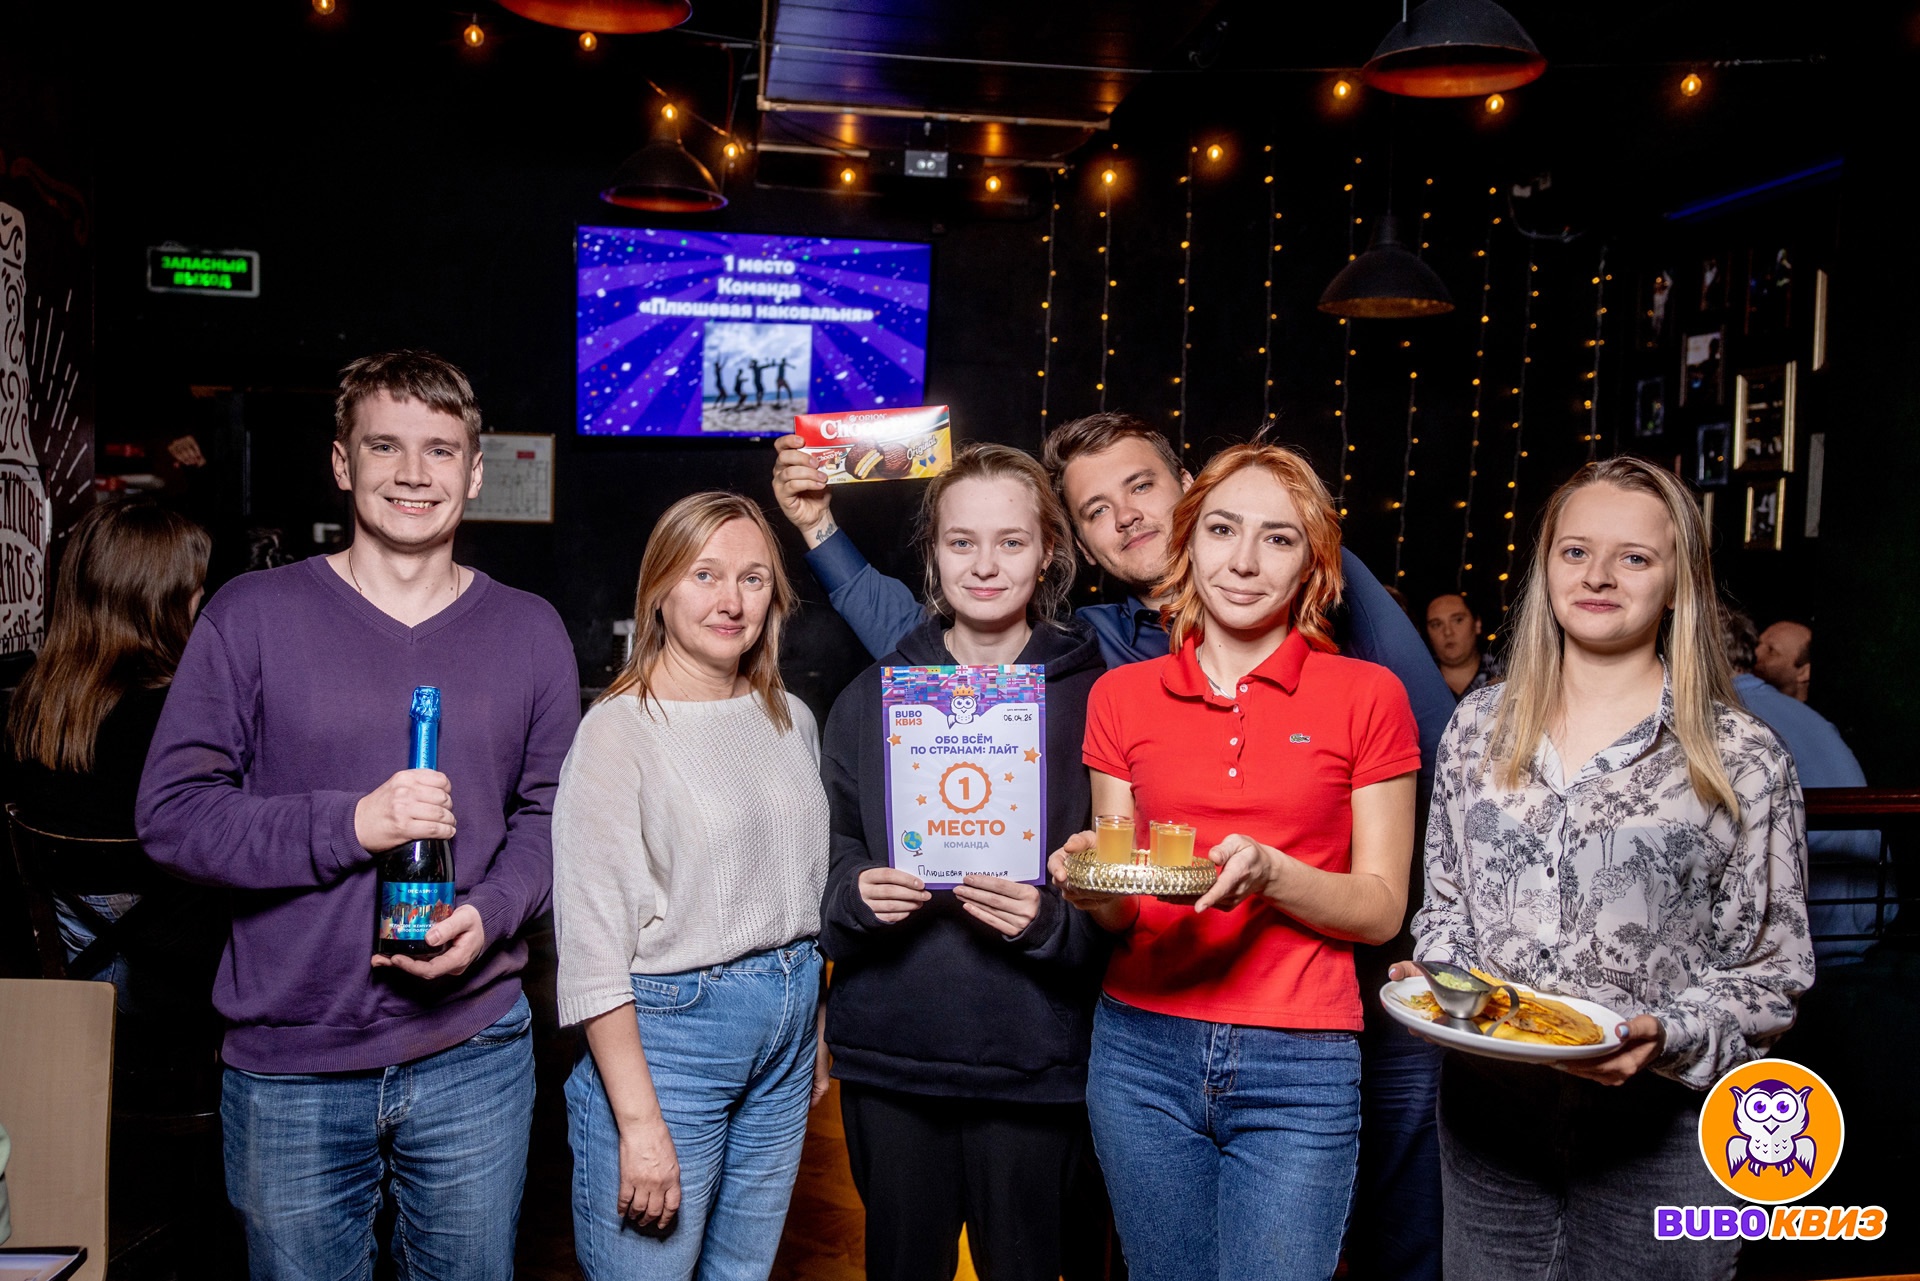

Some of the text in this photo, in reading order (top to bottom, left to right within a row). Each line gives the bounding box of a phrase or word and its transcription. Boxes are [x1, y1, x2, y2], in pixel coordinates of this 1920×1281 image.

[161, 256, 247, 272] ЗАПАСНЫЙ
[724, 255, 796, 275] 1 место
[173, 271, 232, 288] ВЫХОД
[717, 277, 801, 300] Команда
[638, 297, 874, 322] «Плюшевая наковальня»
[907, 434, 938, 460] Original
[0, 471, 43, 555] NTURE
[895, 710, 923, 719] BUBO
[895, 718, 923, 726] КВИЗ
[935, 733, 993, 745] ОБО ВСЁМ
[911, 743, 1019, 755] ПО СТРАНАМ: ЛАЙТ
[958, 777, 970, 801] 1
[927, 820, 1006, 836] МЕСТО
[944, 841, 990, 850] КОМАНДА
